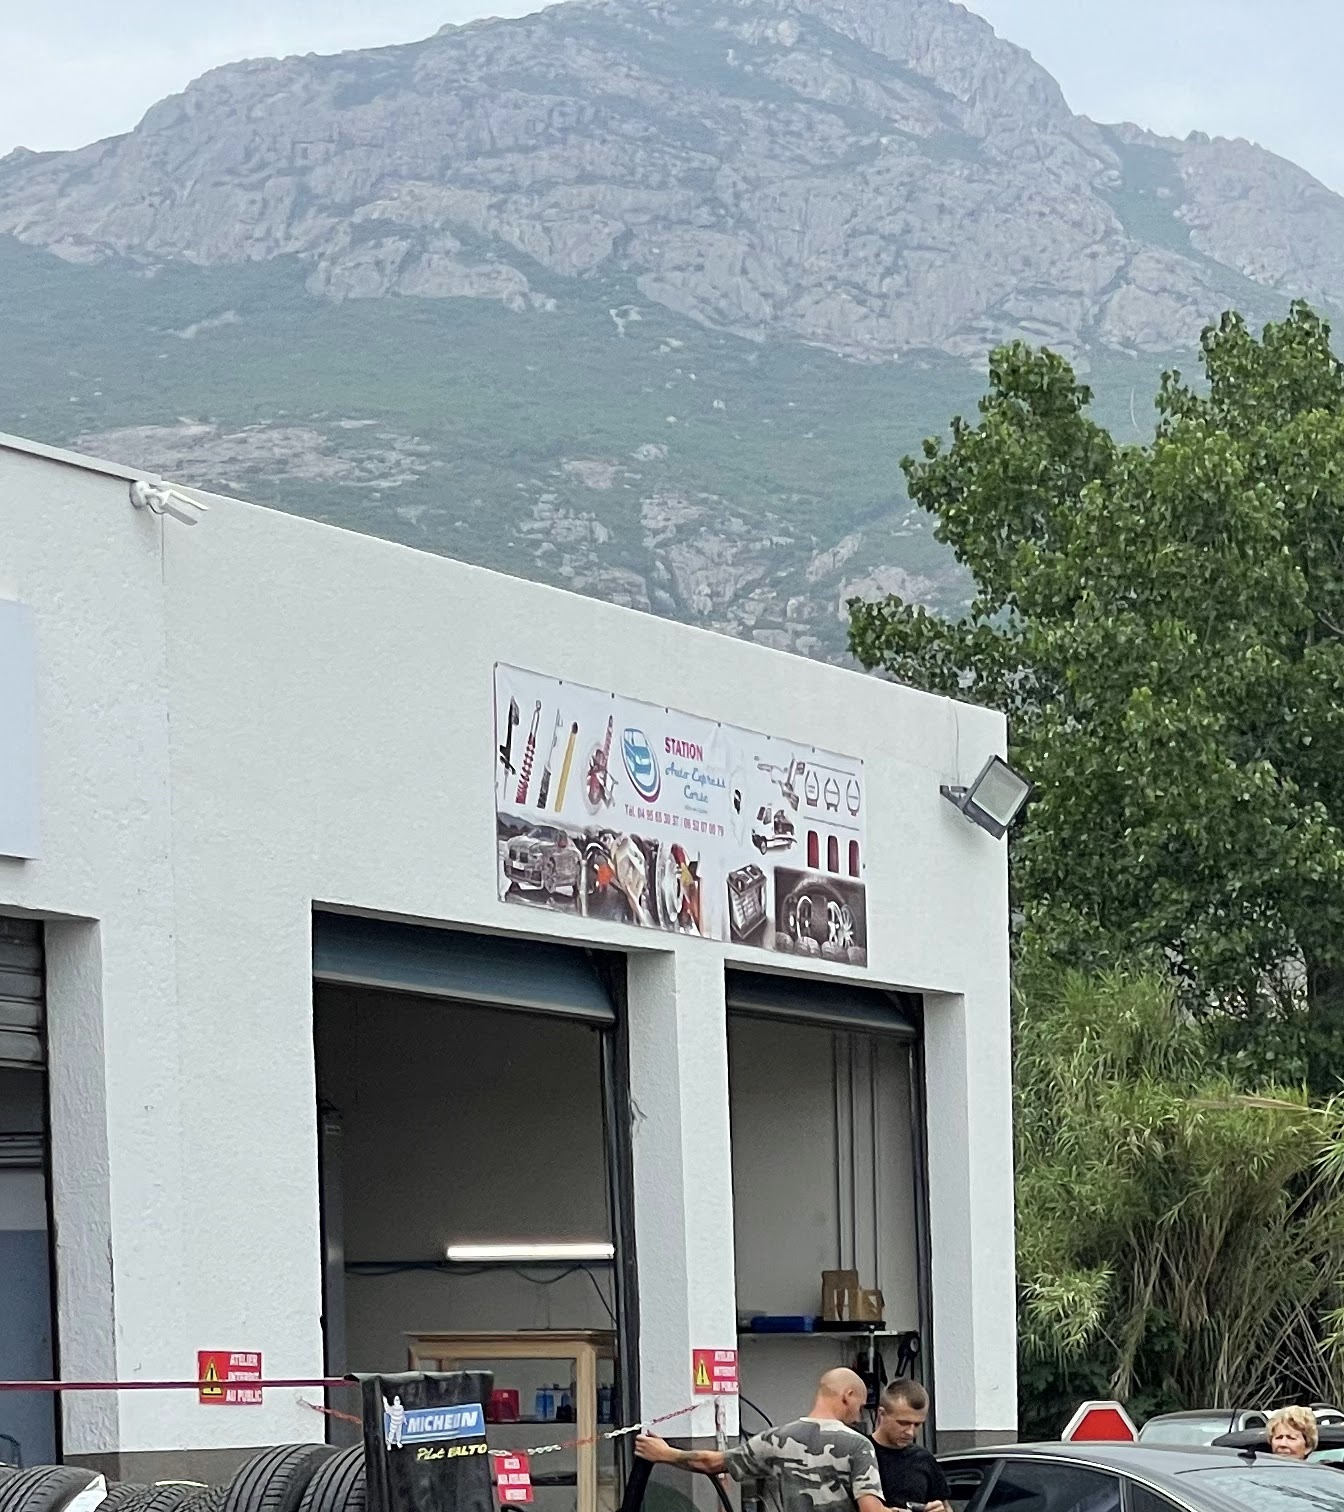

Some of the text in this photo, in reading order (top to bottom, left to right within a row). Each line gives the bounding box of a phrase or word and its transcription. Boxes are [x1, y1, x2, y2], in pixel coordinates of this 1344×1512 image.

[664, 737, 704, 762] STATION
[229, 1353, 258, 1366] ATELIER
[225, 1389, 262, 1403] AU PUBLIC
[406, 1411, 478, 1434] MICHELIN
